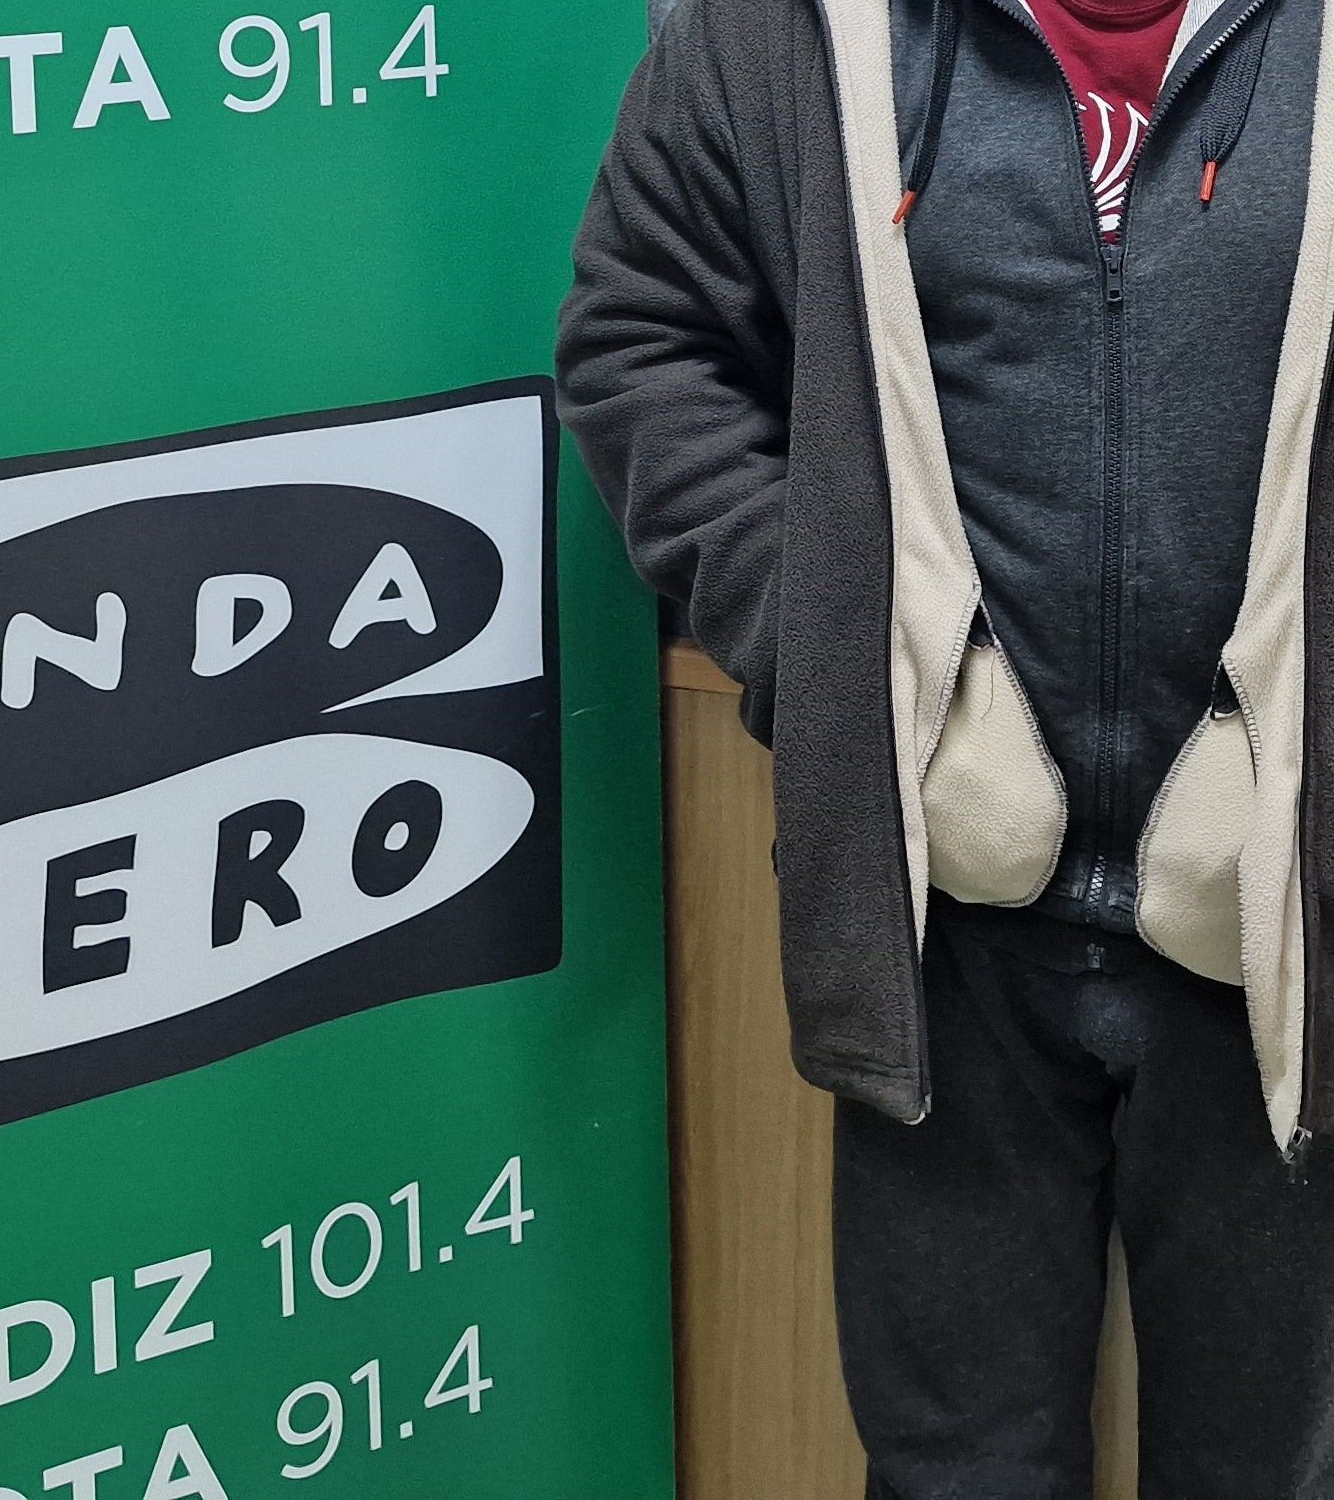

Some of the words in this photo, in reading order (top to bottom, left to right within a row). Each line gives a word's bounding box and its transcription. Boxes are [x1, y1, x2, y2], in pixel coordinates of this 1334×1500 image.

[218, 4, 450, 114] 91.4
[261, 1155, 535, 1318] 101.4
[276, 1324, 494, 1480] 91.4
